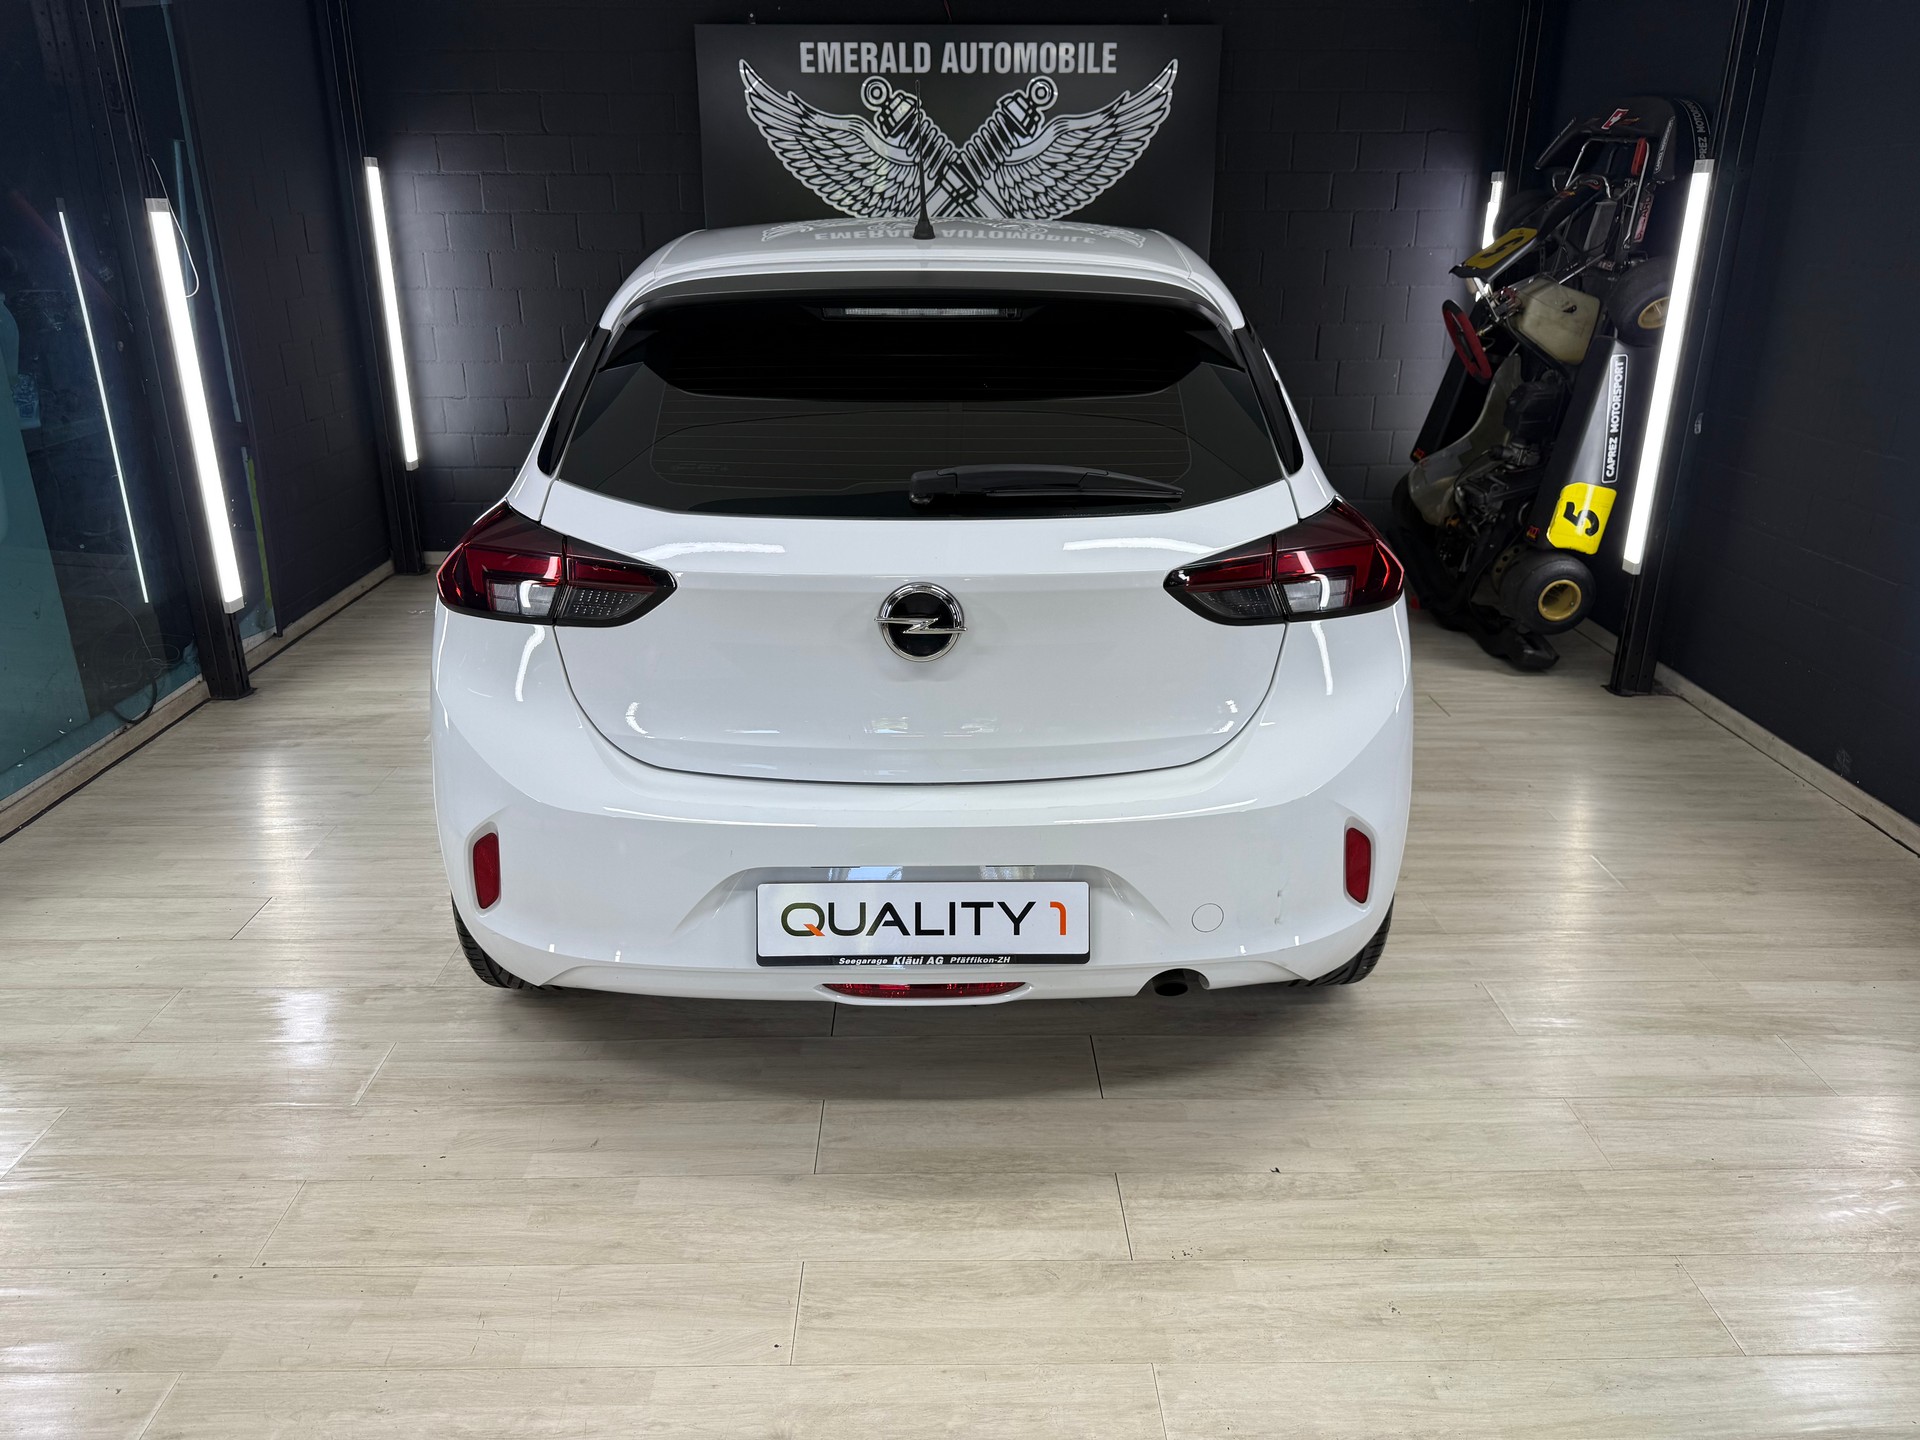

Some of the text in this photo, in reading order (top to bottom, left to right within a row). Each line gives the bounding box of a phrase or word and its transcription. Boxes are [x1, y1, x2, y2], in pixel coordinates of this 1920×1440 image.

[800, 42, 1118, 74] EMERALD AUTOMOBILE
[1697, 136, 1709, 160] PREZ
[1605, 360, 1625, 478] CAPREZ MOTORSPORT
[1563, 501, 1600, 537] 5
[780, 901, 1067, 937] QUALITY 1
[838, 955, 1011, 966] Seegarage Kläui AG Pfäffikon-ZH
